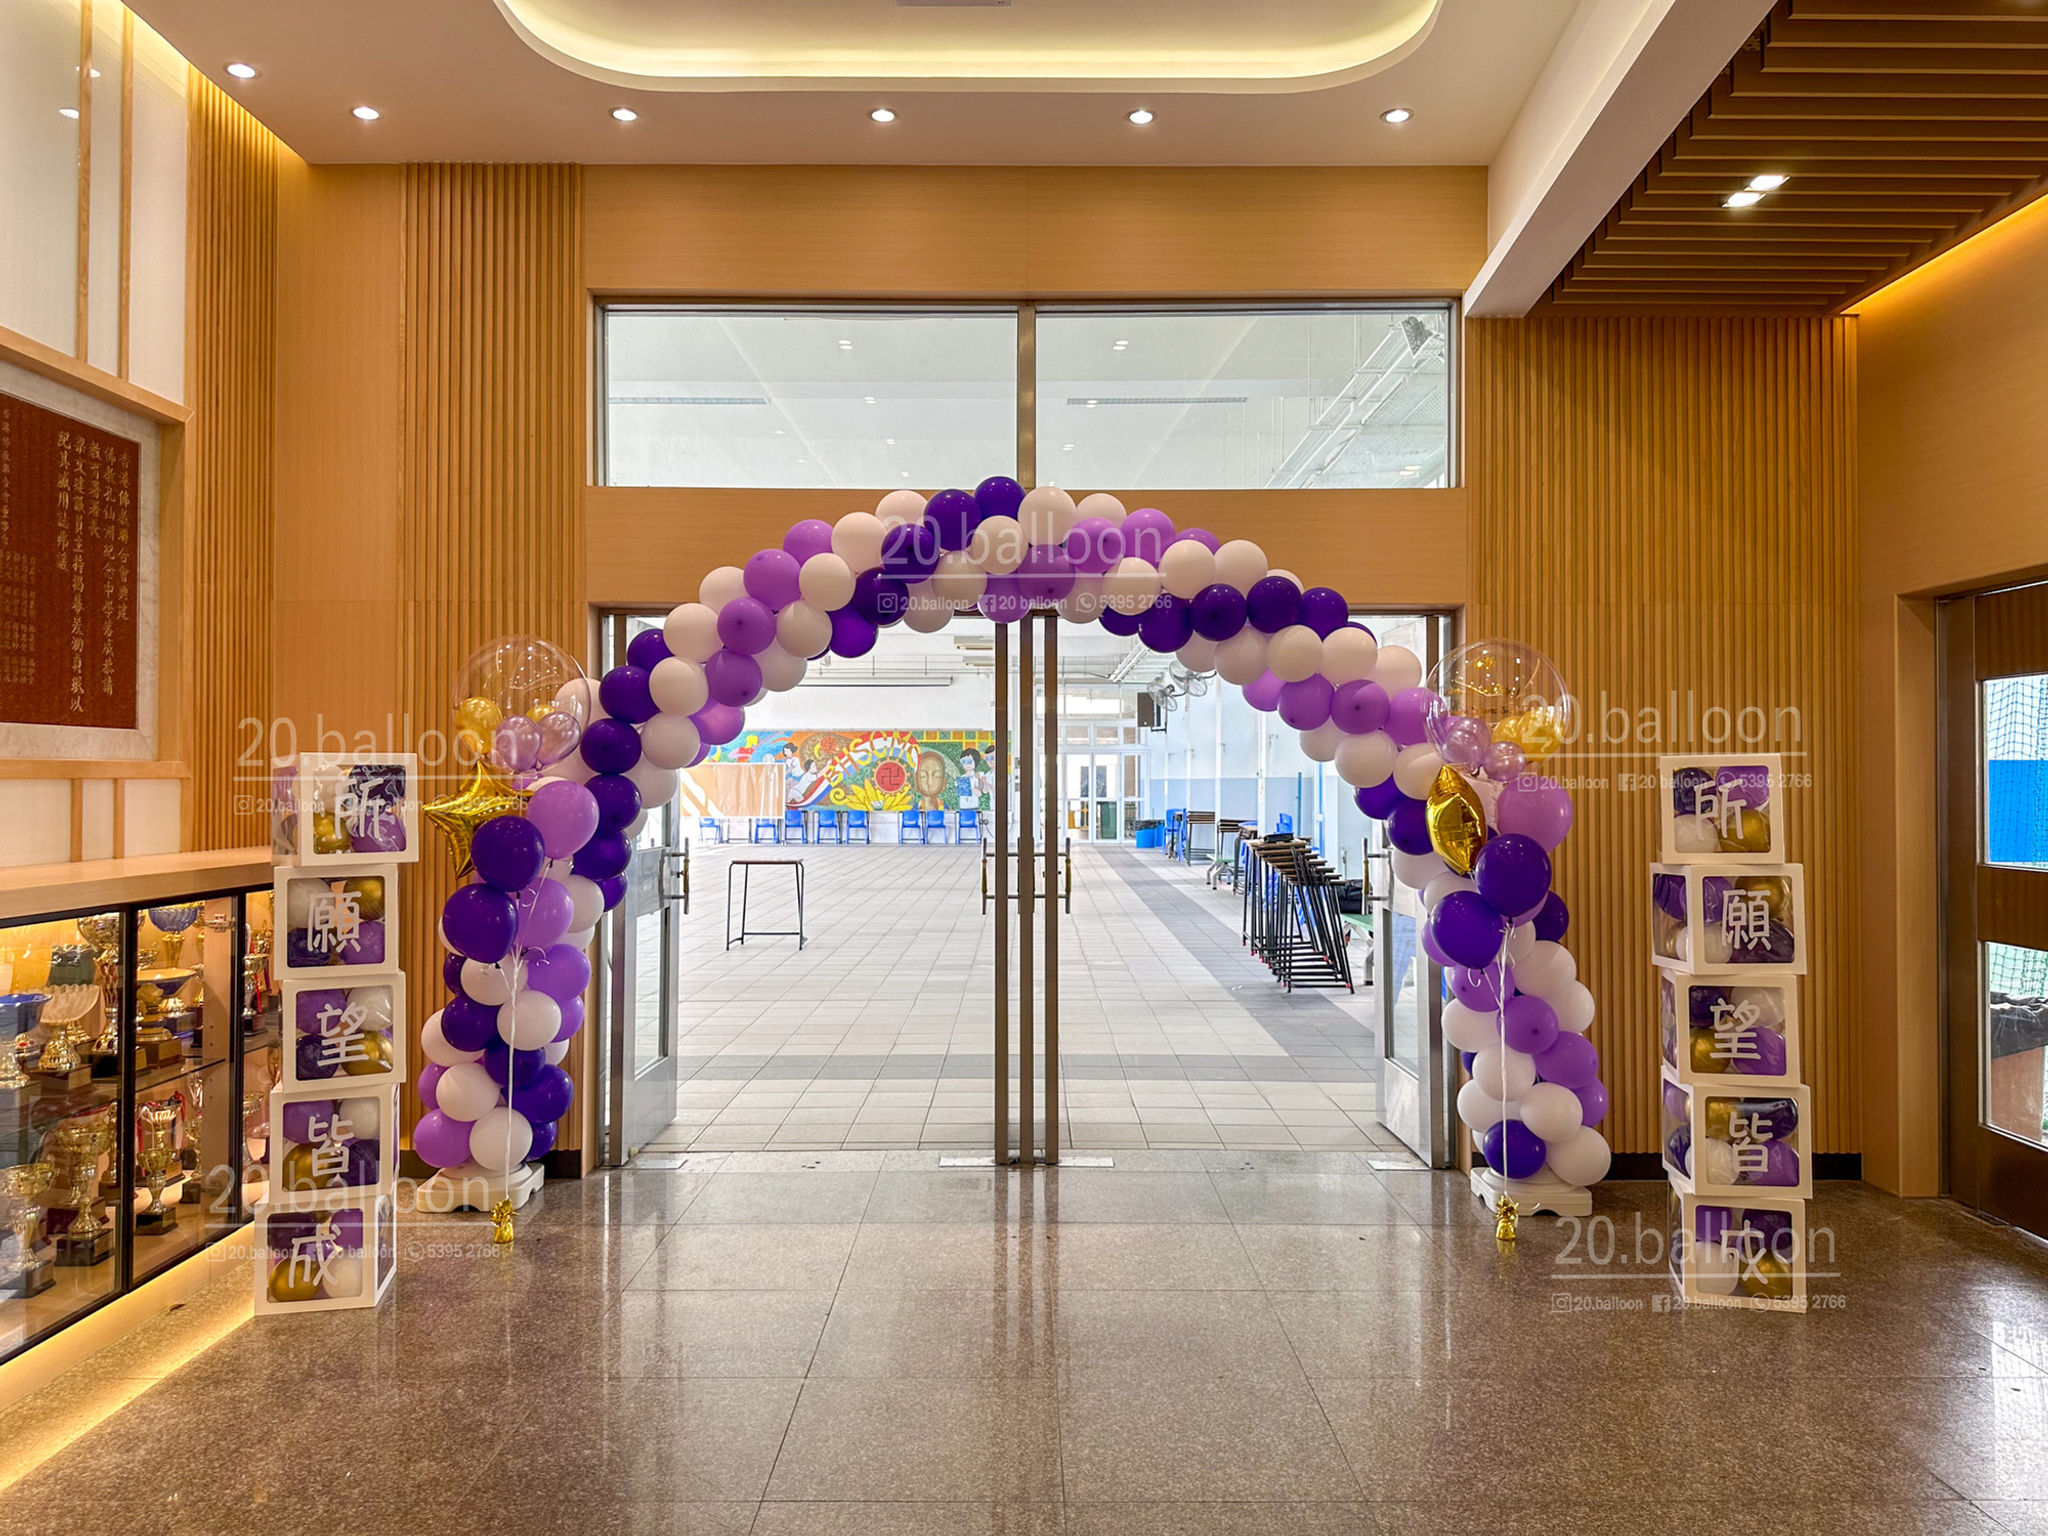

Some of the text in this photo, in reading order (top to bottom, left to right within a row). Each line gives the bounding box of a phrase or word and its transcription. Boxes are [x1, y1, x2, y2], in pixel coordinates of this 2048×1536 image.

[333, 777, 385, 840] 所
[1693, 778, 1747, 841] 所
[306, 891, 362, 953] 願
[1721, 889, 1772, 951] 願
[316, 1003, 369, 1067] 望
[1710, 998, 1761, 1060] 望
[307, 1113, 354, 1177] 皆
[1728, 1112, 1773, 1173] 皆
[288, 1222, 342, 1289] 成
[1720, 1219, 1769, 1285] 成
